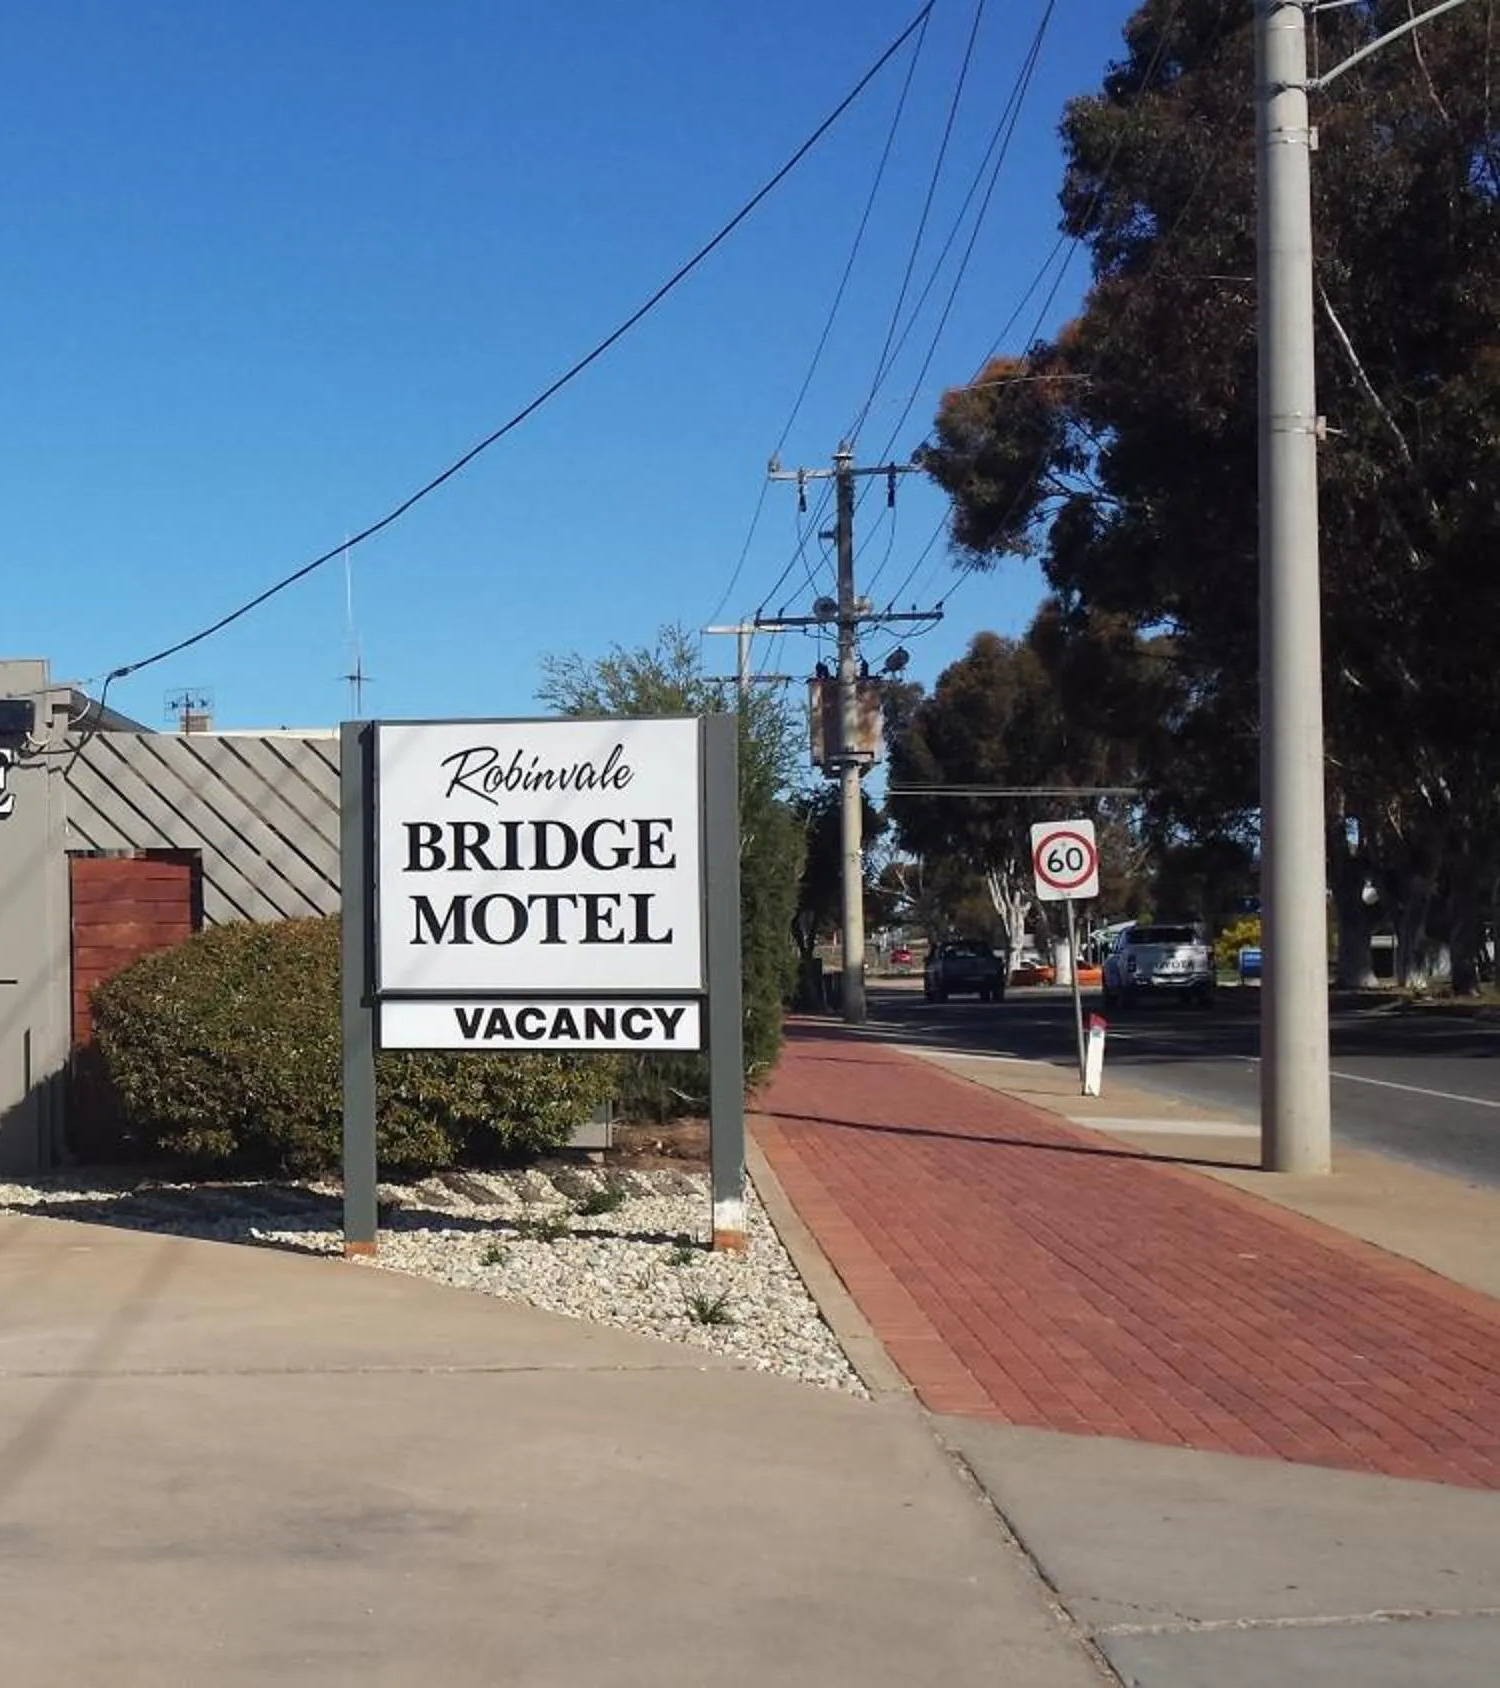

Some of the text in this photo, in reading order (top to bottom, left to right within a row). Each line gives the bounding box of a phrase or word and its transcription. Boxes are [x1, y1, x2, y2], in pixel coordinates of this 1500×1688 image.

[441, 744, 634, 805] Robinvale
[402, 818, 676, 872] BRIDGE
[1047, 847, 1083, 873] 60
[409, 893, 674, 946] MOTEL
[454, 1007, 686, 1041] VACANCY
